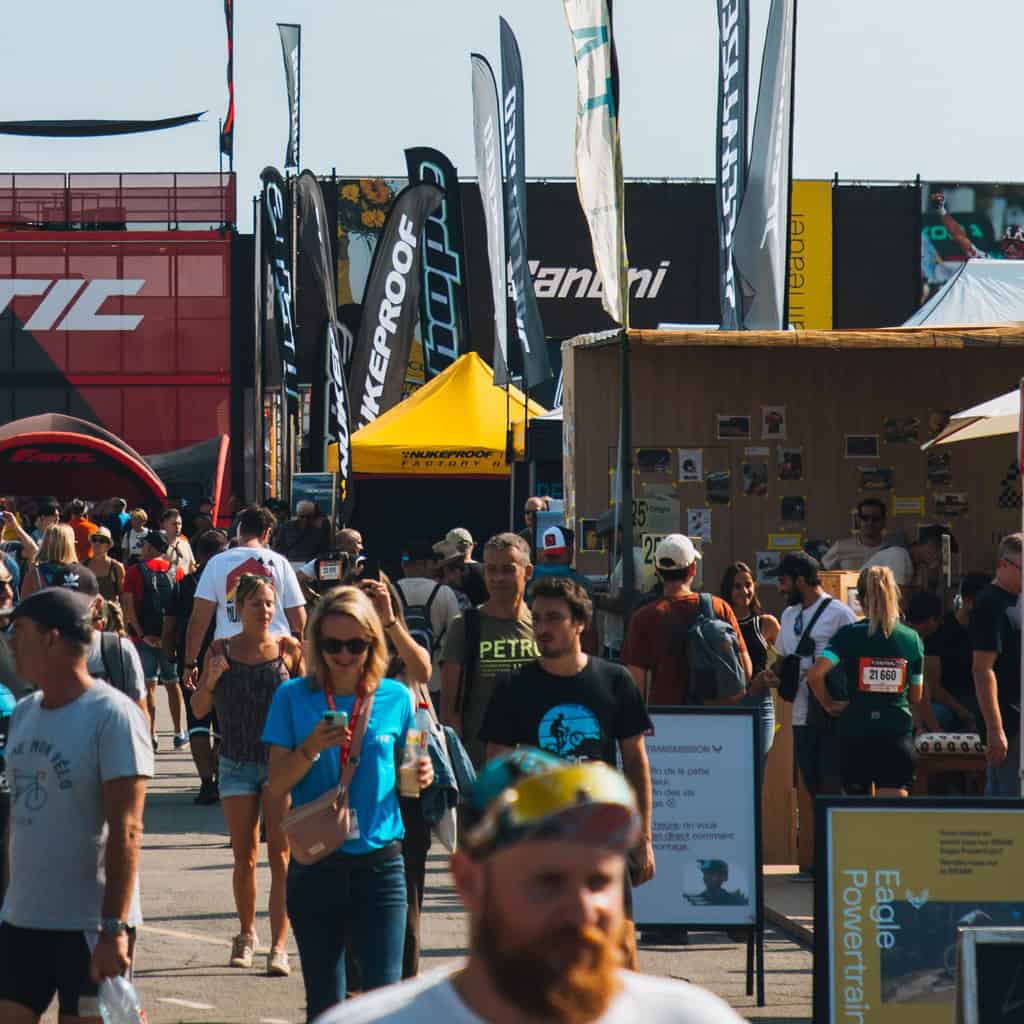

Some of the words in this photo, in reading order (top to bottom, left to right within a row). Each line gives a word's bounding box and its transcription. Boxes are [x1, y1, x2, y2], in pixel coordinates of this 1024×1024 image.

[507, 261, 670, 299] anni
[401, 460, 480, 468] FACTORY
[409, 450, 493, 459] NUKEPROOF
[869, 869, 902, 950] Eagle
